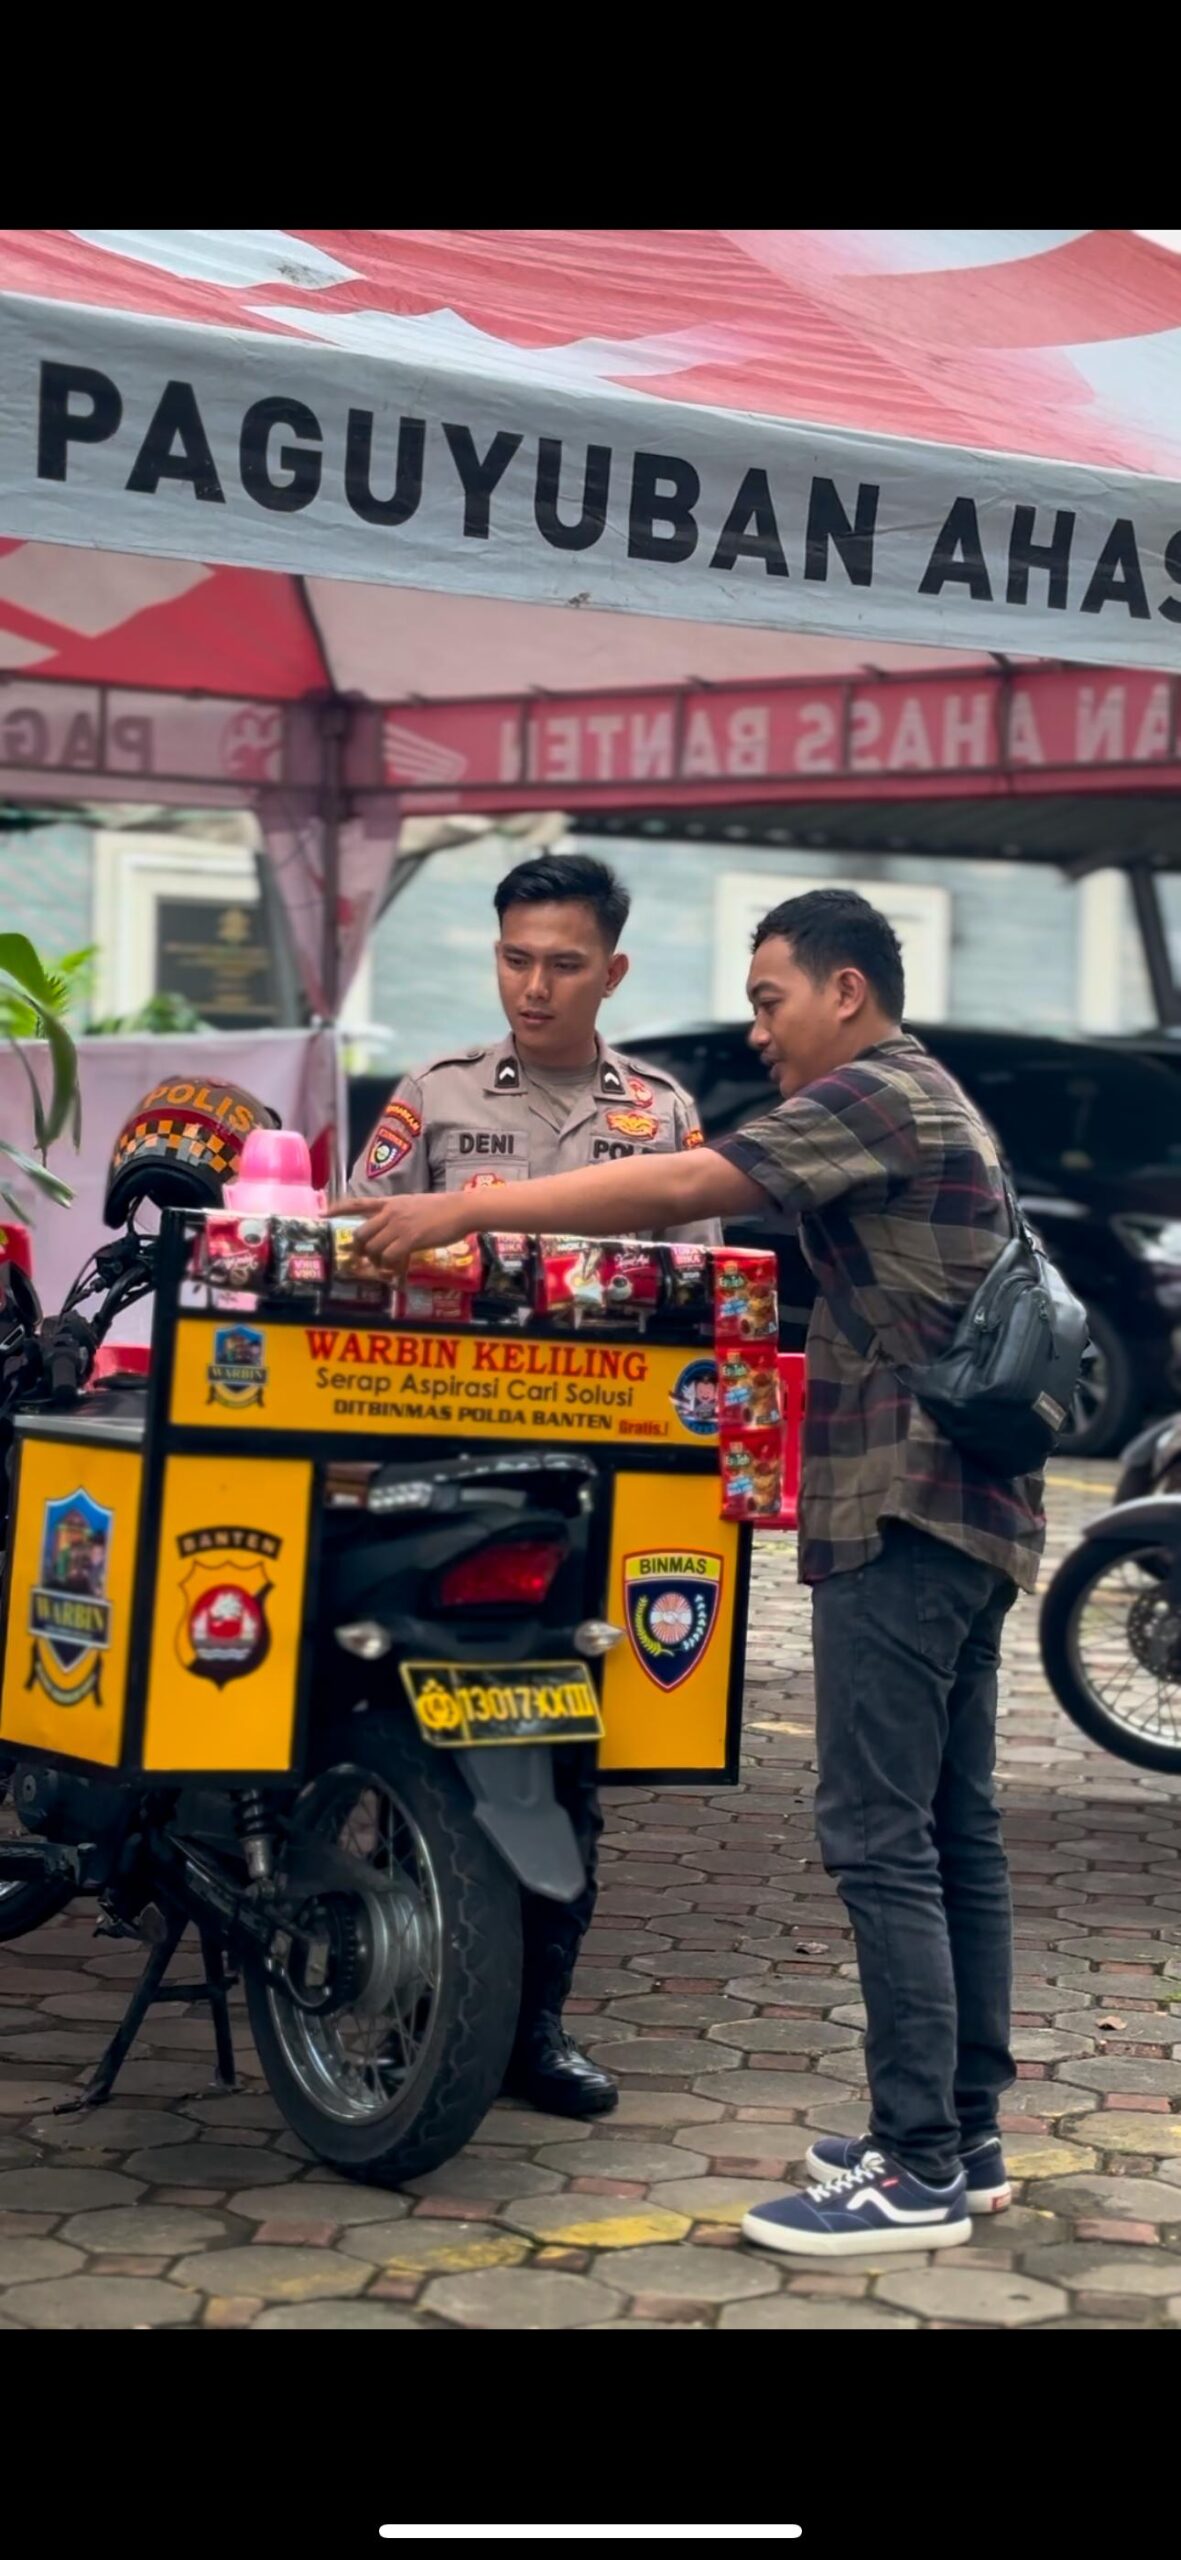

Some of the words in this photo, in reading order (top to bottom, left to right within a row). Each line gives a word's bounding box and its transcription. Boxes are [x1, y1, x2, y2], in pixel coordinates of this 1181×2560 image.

[37, 361, 879, 586] PAGUYUBAN
[143, 1083, 259, 1133] POLIS
[459, 1133, 514, 1155] DENI
[593, 1139, 656, 1160] POL
[305, 1329, 459, 1369] WARBIN
[473, 1341, 648, 1382] KELILING
[212, 1367, 264, 1380] WARBIN
[316, 1367, 392, 1396] Serap
[400, 1373, 499, 1399] Aspirasi
[507, 1379, 558, 1402] Cari
[565, 1383, 634, 1407] Solusi
[334, 1399, 452, 1421] DITBINMAS
[458, 1406, 526, 1425] POLDA
[532, 1409, 613, 1430] BANTEN
[182, 1530, 277, 1553] BANTEN
[638, 1557, 707, 1575] BINMAS
[36, 1596, 105, 1631] WARBIN
